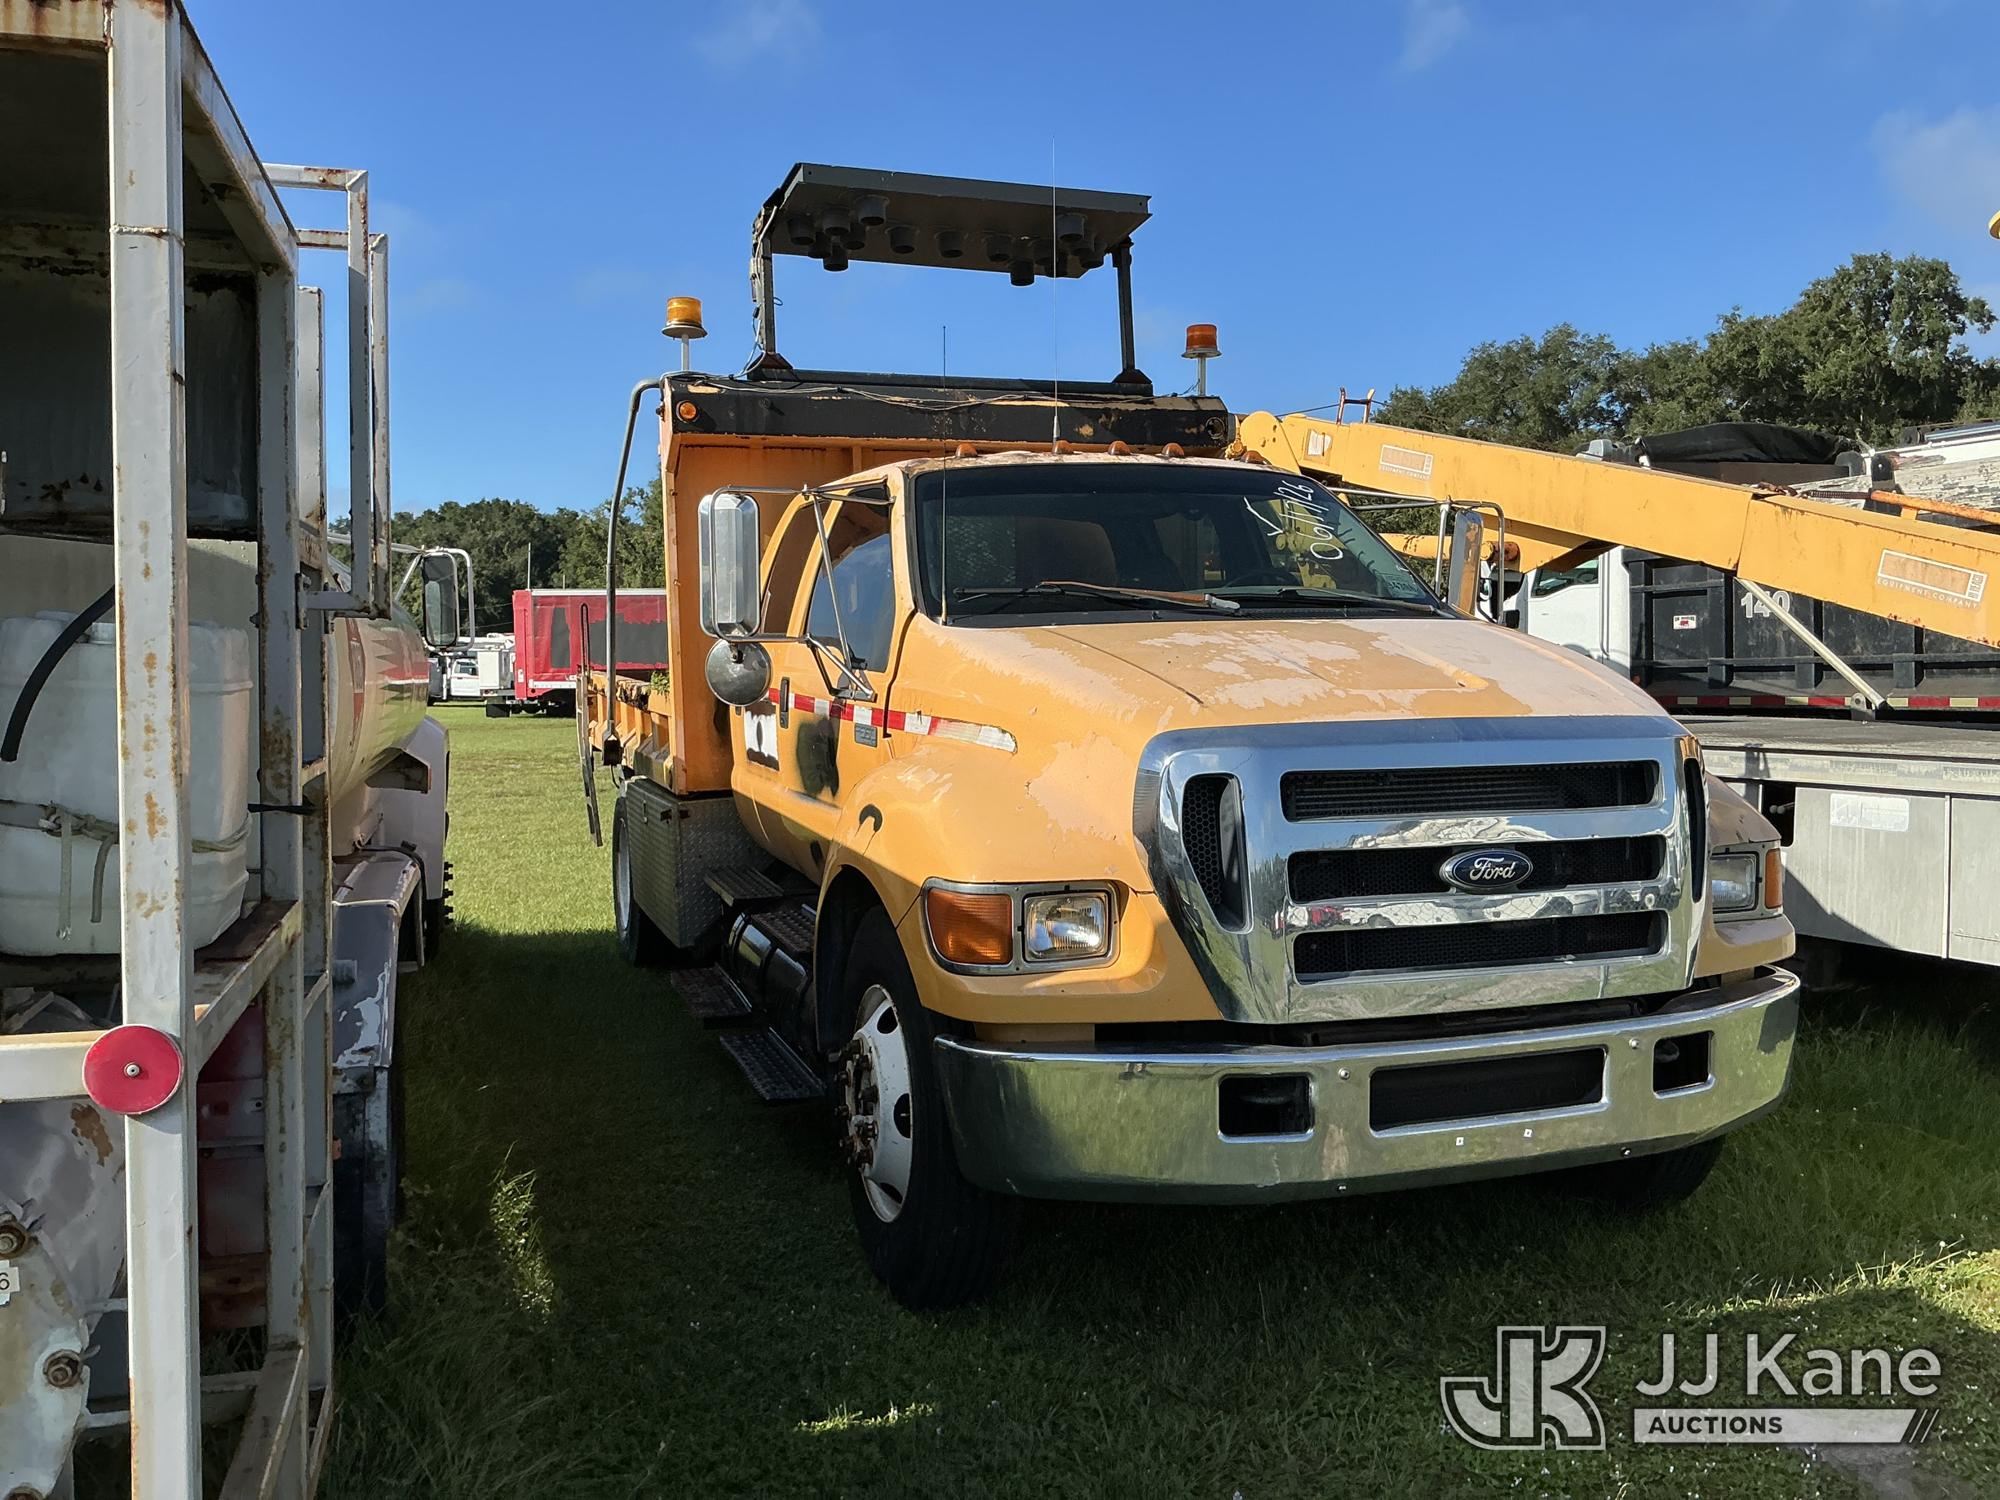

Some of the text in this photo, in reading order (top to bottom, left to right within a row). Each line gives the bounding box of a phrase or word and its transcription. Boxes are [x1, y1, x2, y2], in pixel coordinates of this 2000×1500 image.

[1740, 590, 1790, 619] 140
[1876, 577, 1978, 609] EQUIPMENT COMPANY
[1469, 857, 1516, 881] Ford
